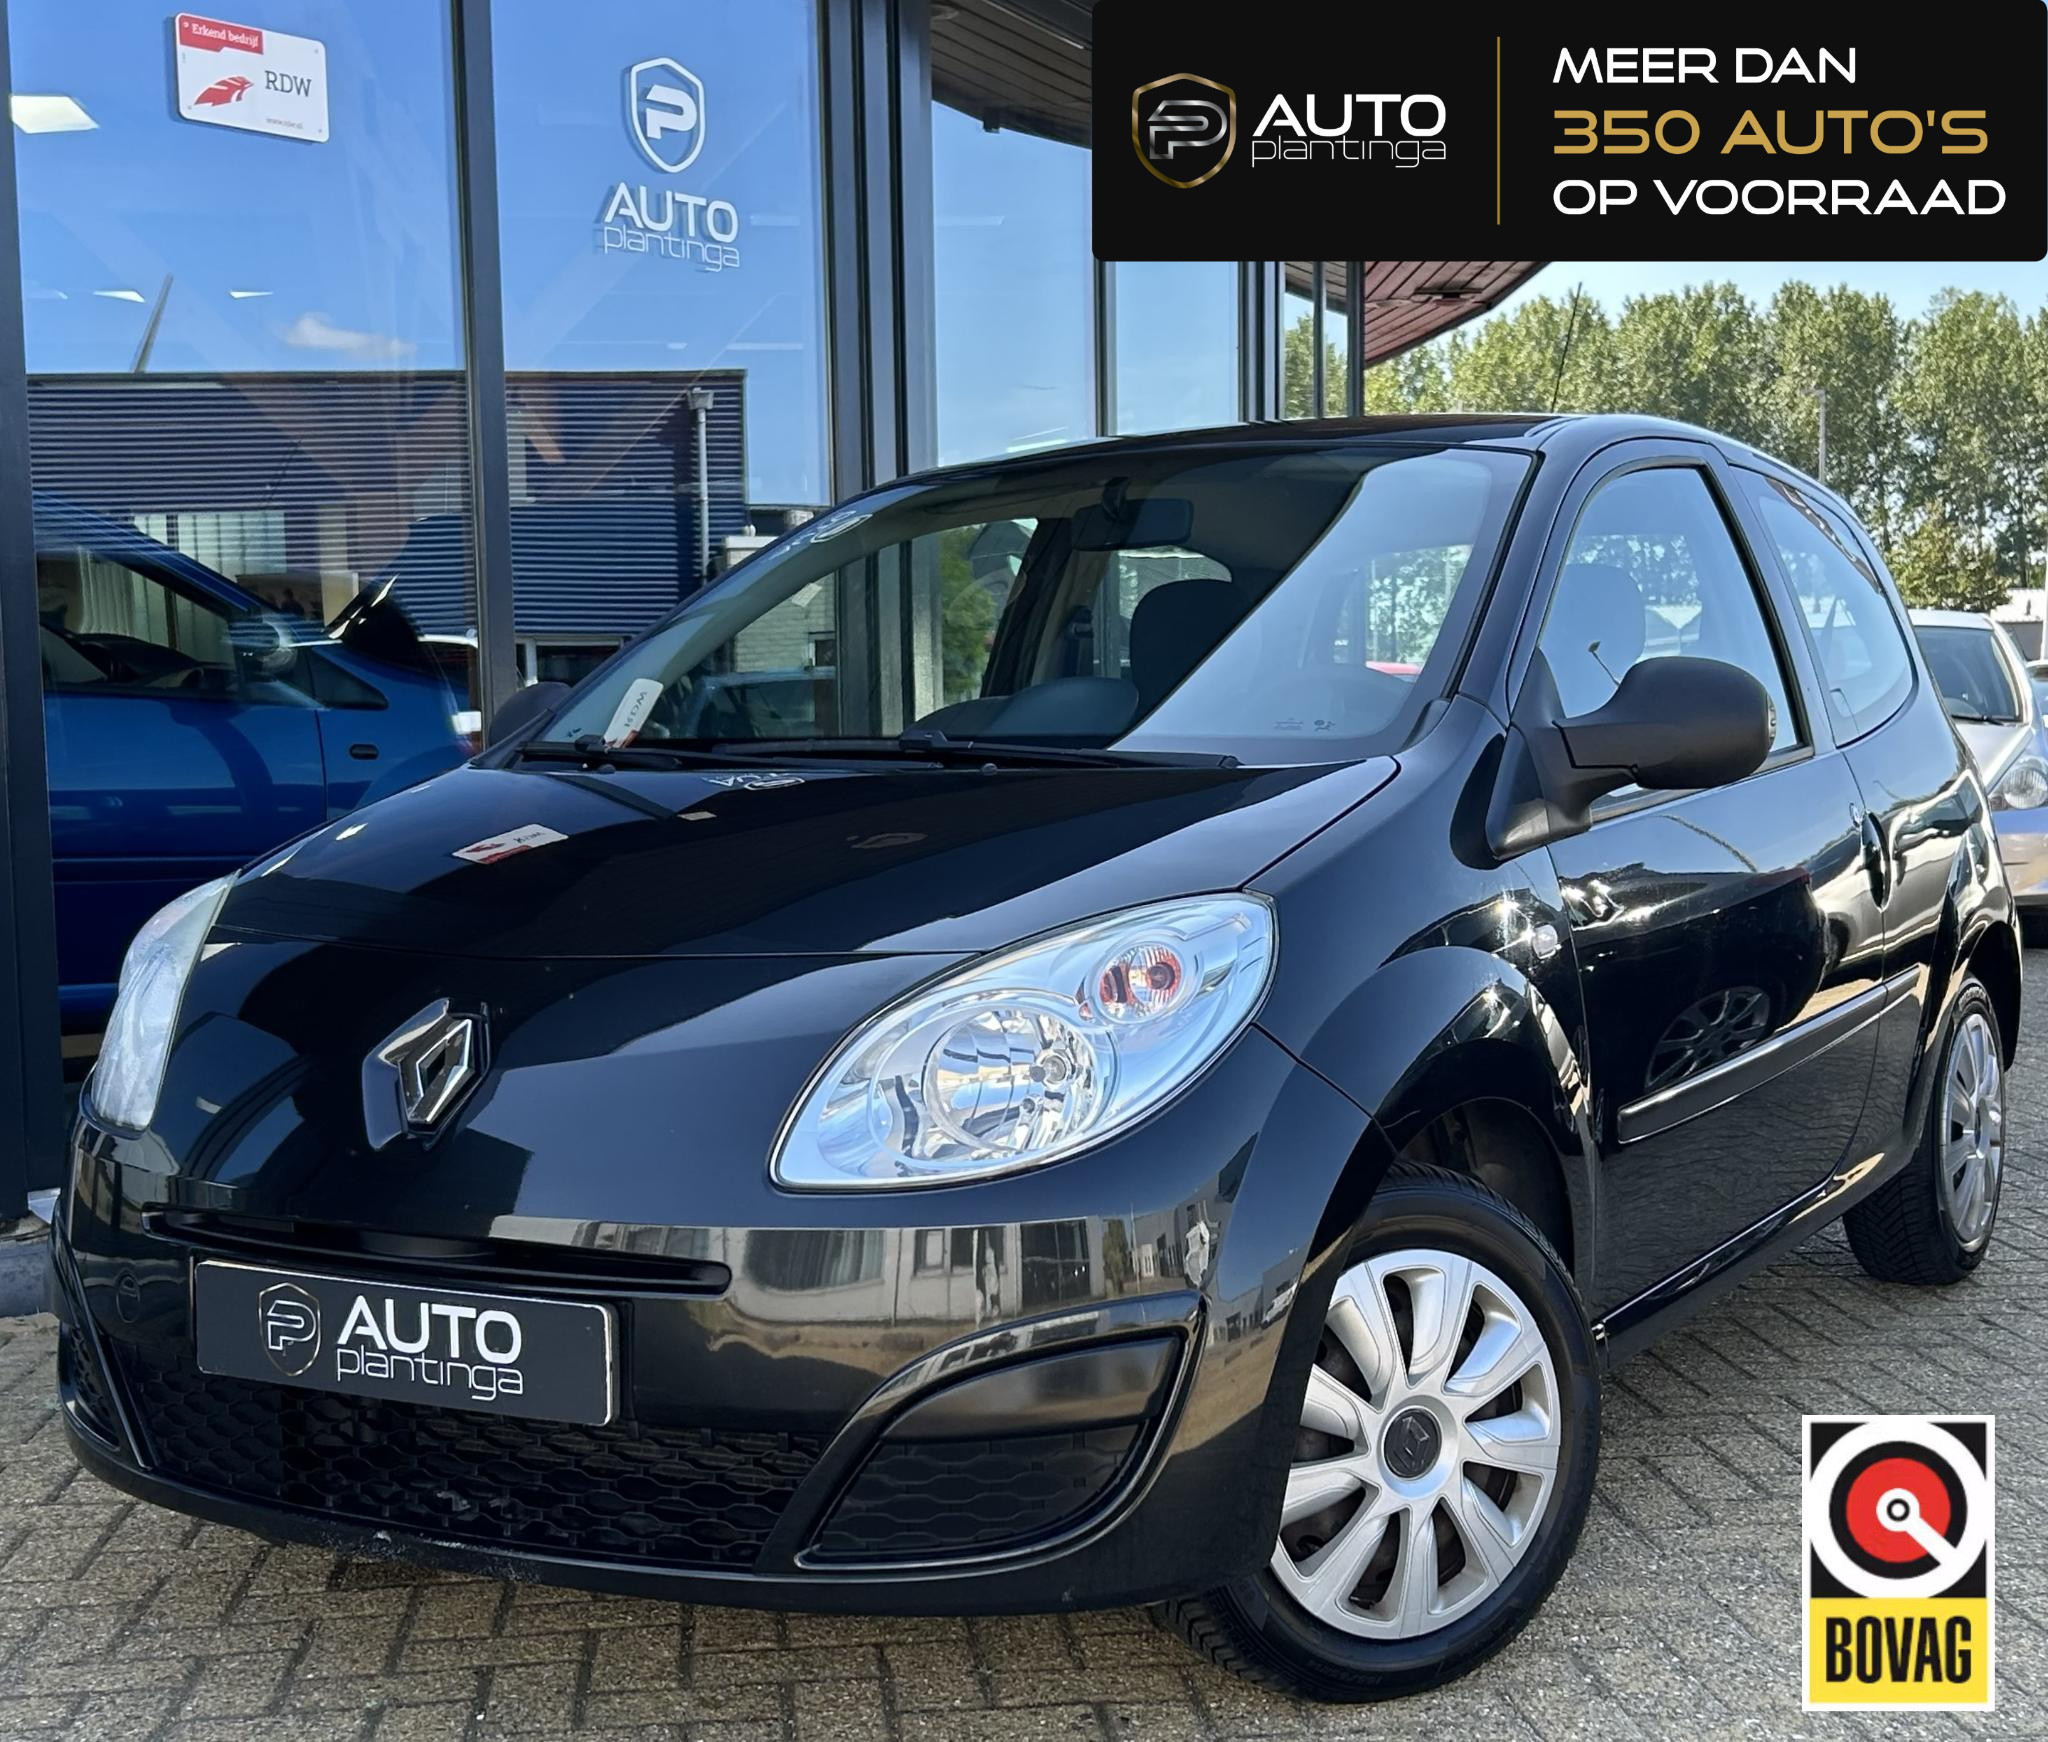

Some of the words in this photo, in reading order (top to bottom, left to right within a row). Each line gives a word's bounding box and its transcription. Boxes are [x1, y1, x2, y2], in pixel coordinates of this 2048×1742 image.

[191, 23, 226, 40] Erkend
[228, 31, 259, 48] bedrijf
[264, 70, 312, 97] RDW
[604, 182, 739, 244] AUTO
[603, 223, 741, 273] plantinga
[336, 1294, 522, 1365] AUTO
[336, 1343, 524, 1400] plantinga
